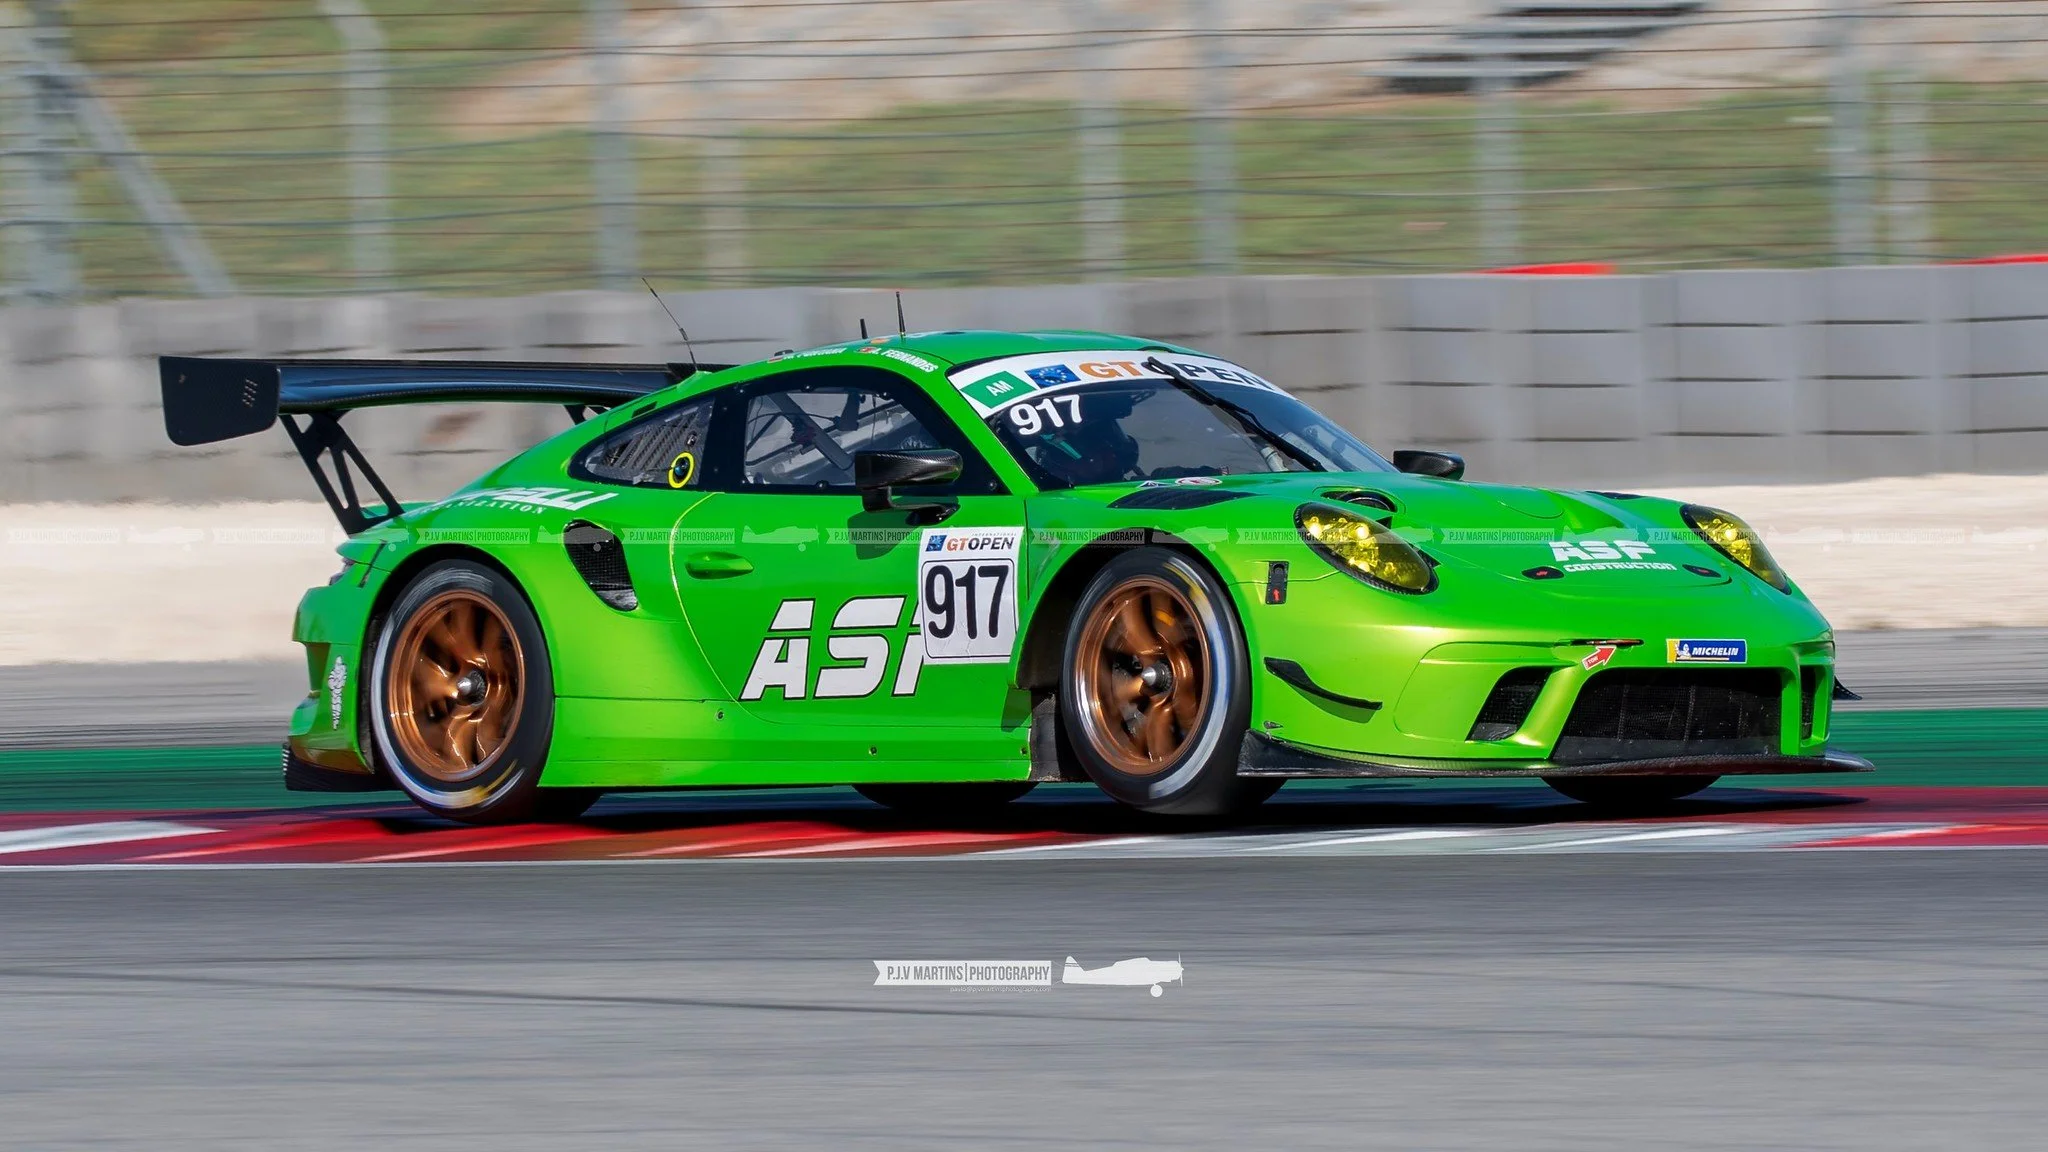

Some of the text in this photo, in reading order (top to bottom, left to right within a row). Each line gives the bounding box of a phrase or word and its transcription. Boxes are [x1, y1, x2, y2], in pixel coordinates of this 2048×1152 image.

[881, 349, 939, 373] FERNANDES
[985, 380, 1014, 397] AM
[1010, 394, 1083, 435] 917
[1548, 540, 1656, 562] ASF
[1563, 561, 1678, 573] CONSTRUCTION
[924, 564, 1010, 640] 917
[1691, 646, 1739, 656] MICHELIN
